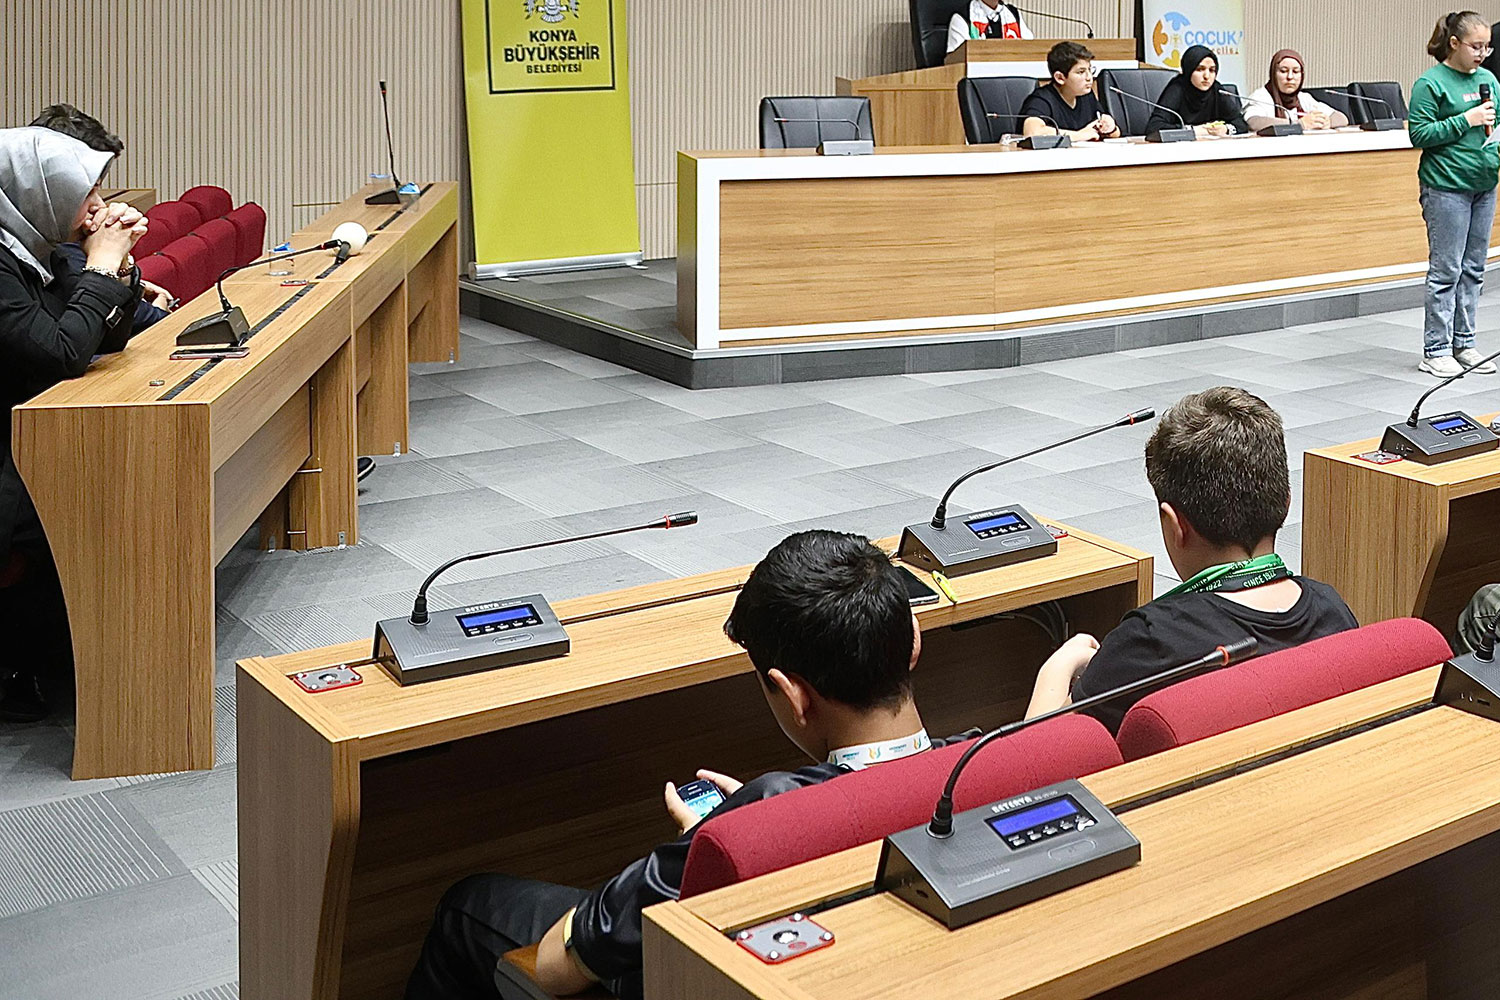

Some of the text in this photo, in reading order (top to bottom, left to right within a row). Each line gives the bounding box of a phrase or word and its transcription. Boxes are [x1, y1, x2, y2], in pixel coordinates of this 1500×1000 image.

[529, 30, 577, 42] KONYA
[504, 42, 600, 62] BÜYÜKŞEHİR
[526, 63, 582, 74] BELEDİYESİ
[1243, 575, 1265, 588] SINCE
